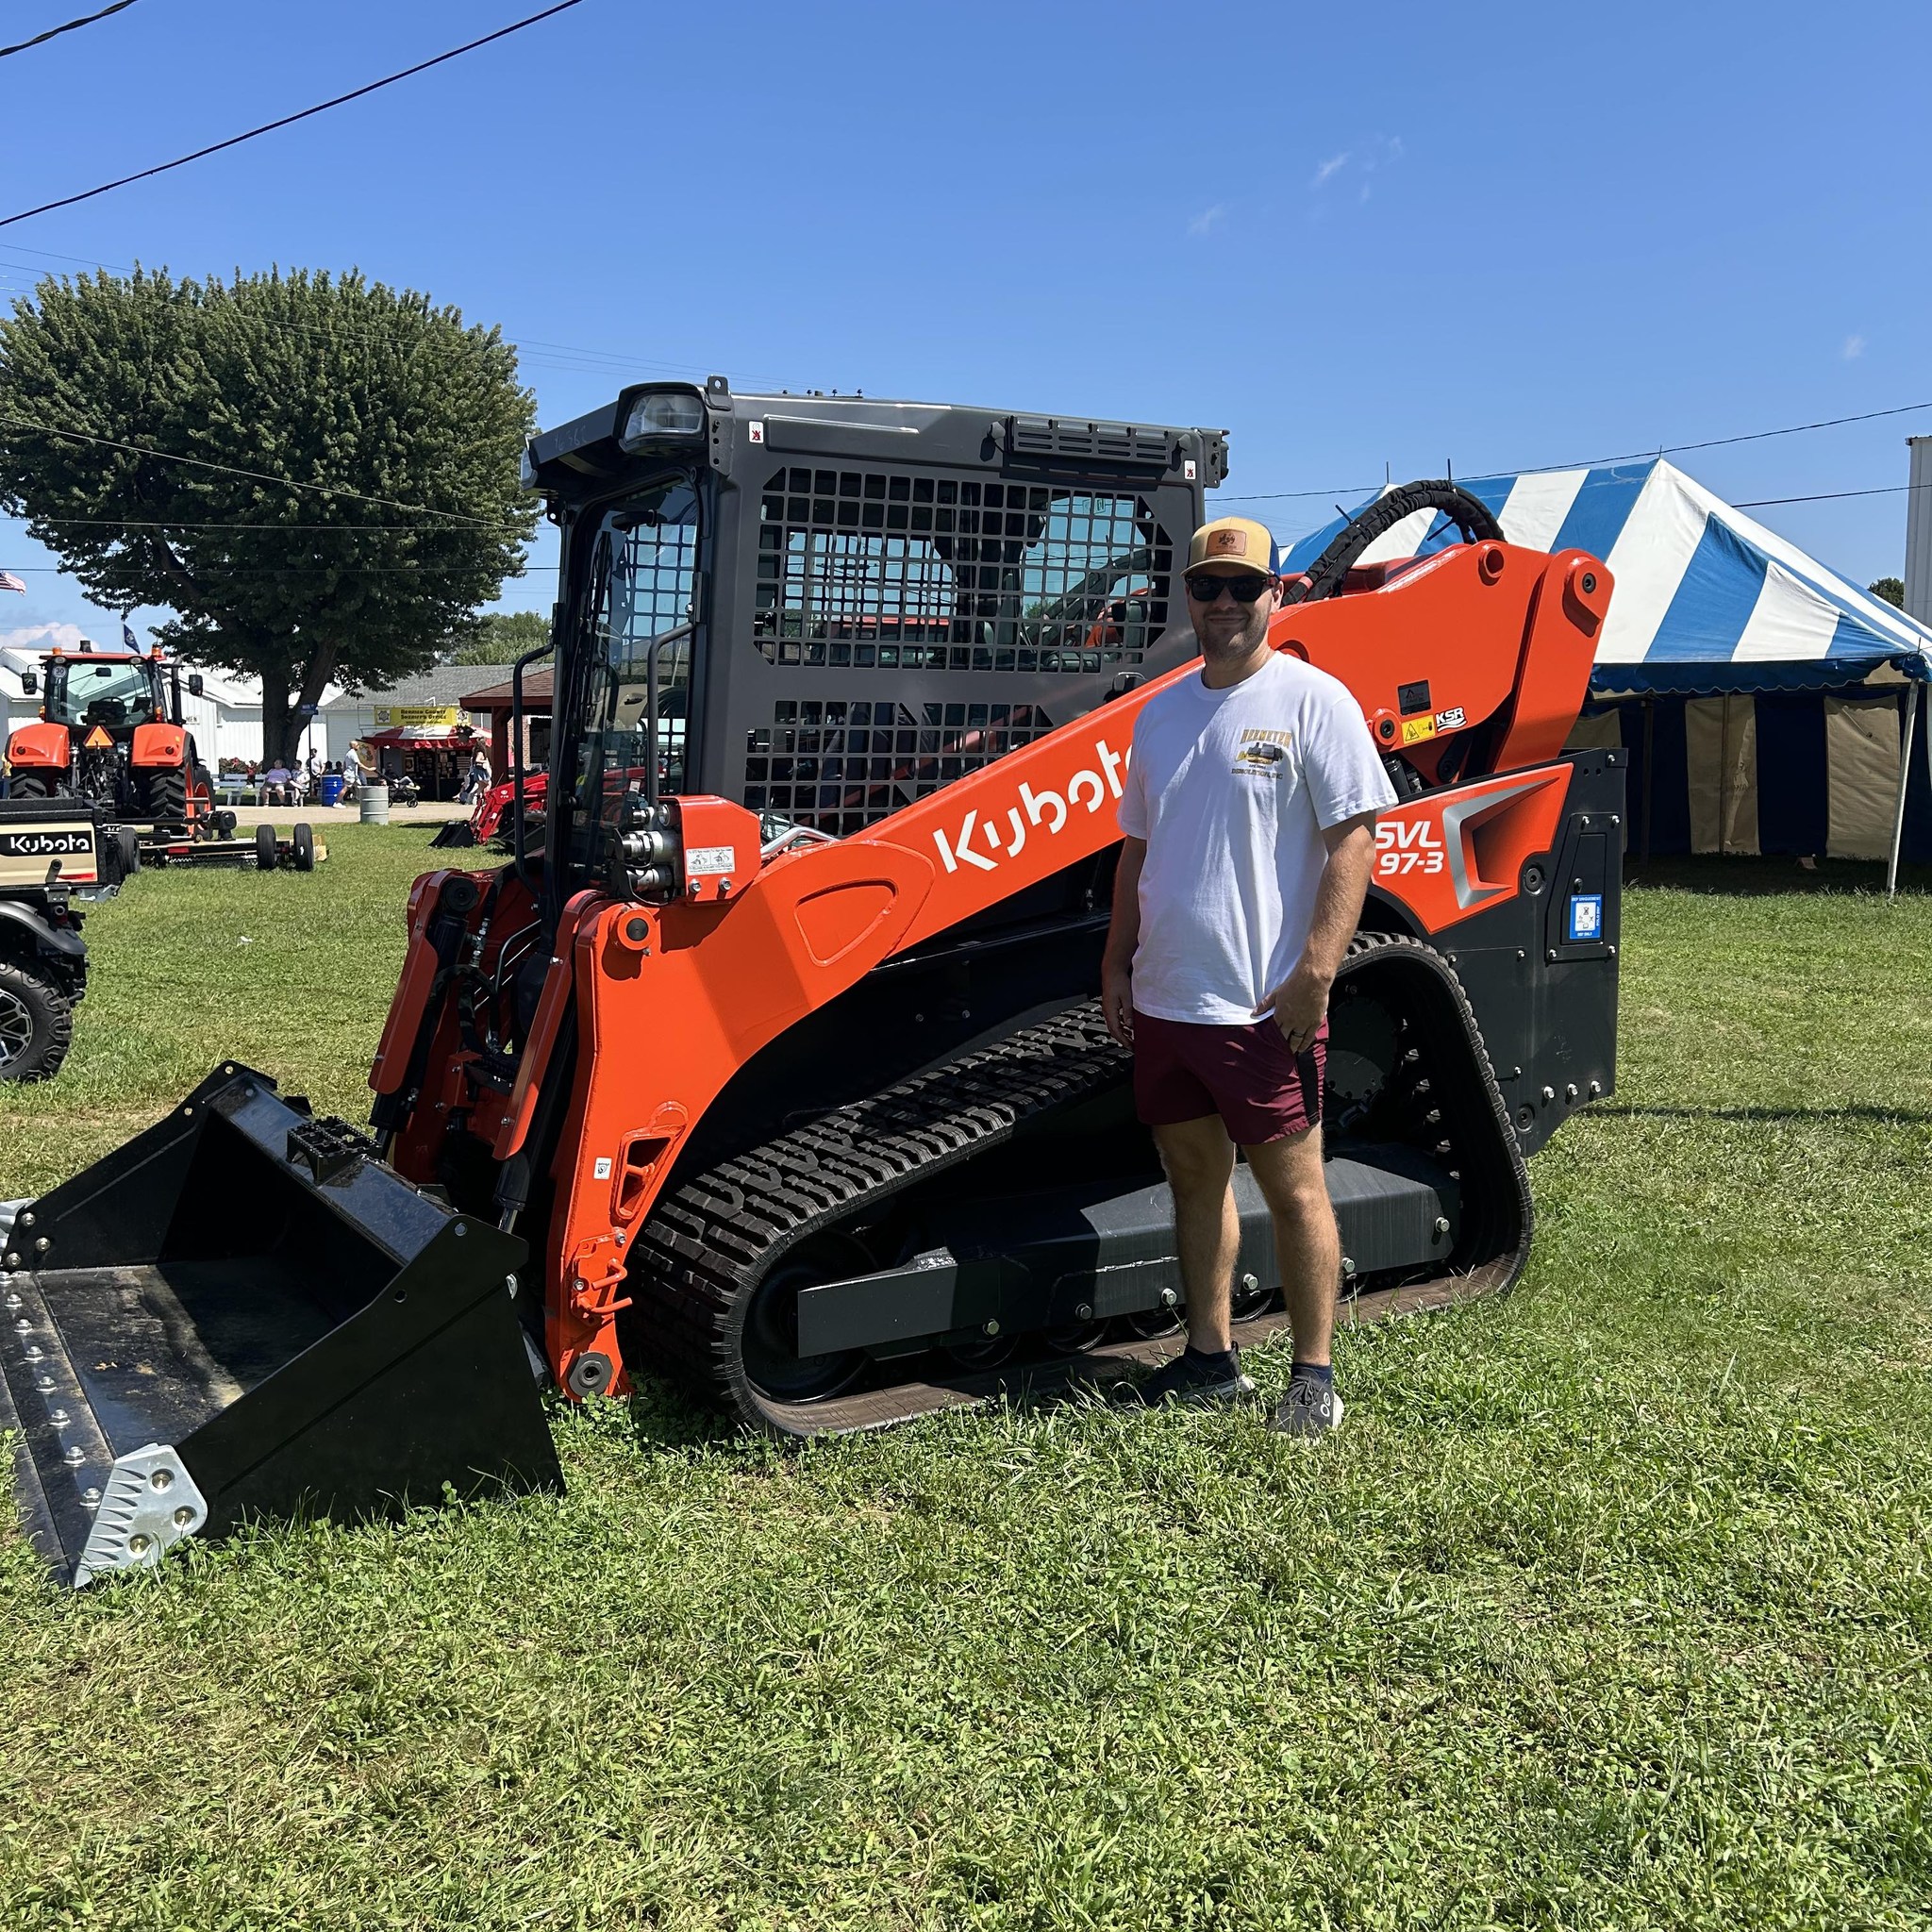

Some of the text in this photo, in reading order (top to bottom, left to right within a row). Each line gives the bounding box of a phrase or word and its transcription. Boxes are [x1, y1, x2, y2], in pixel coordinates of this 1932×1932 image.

[1436, 707, 1464, 724] KSR
[9, 834, 90, 853] Kubota
[1375, 821, 1441, 849] SVL
[1378, 851, 1444, 875] 97-3
